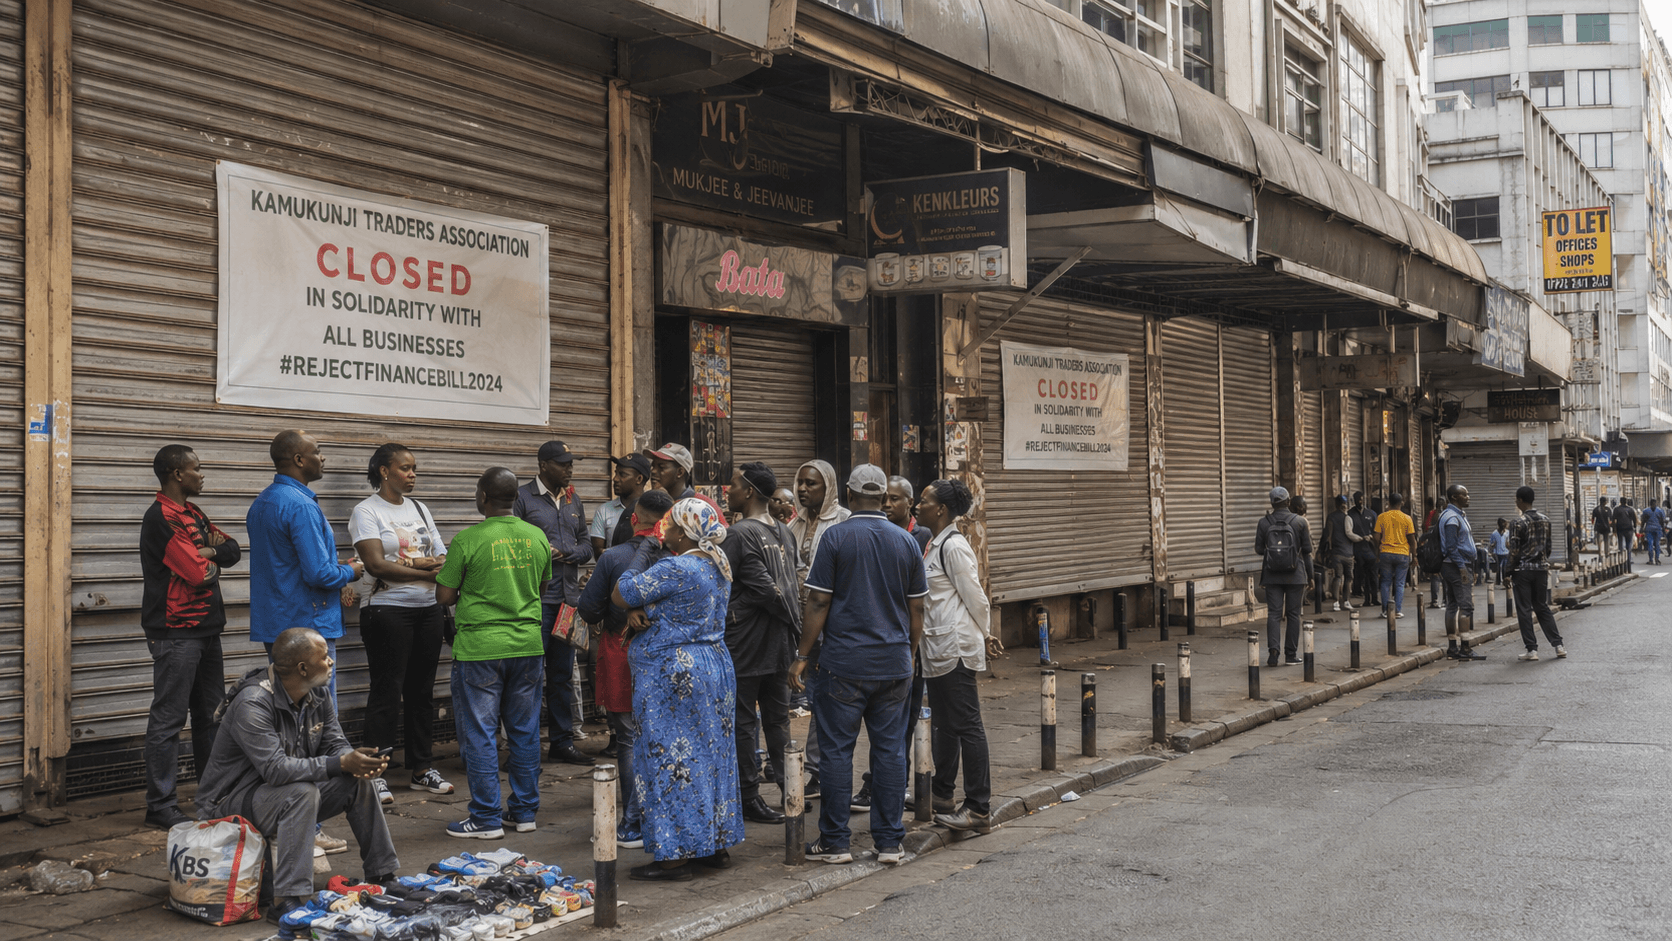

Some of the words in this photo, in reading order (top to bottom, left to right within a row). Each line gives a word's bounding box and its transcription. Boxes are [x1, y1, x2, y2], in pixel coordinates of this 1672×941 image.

[701, 101, 747, 145] MJ
[673, 167, 729, 197] MUKJEE
[733, 182, 743, 200] &
[747, 185, 814, 216] JEEVANJEE
[913, 186, 1000, 213] KENKLEURS
[251, 189, 357, 228] KAMUKUNJI
[363, 209, 434, 241] TRADERS
[439, 224, 529, 259] ASSOCIATION
[1544, 213, 1569, 237] TO
[1575, 210, 1608, 234] LET
[1556, 237, 1598, 253] OFFICES
[1560, 253, 1594, 267] SHOPS
[316, 242, 472, 296] CLOSED
[715, 249, 785, 299] Bata
[306, 286, 325, 308] IN
[332, 289, 436, 322] SOLIDARITY
[440, 305, 481, 328] WITH
[323, 324, 356, 347] ALL
[363, 328, 465, 358] BUSINESSES
[279, 354, 503, 393] #REJECTFINANCEBILL2024
[1013, 353, 1053, 369] KAMUKUNJI
[1038, 378, 1098, 401] CLOSED
[1034, 403, 1042, 414] IN
[1043, 404, 1084, 417] SOLIDARITY
[1086, 406, 1103, 418] WITH
[1041, 423, 1054, 434] ALL
[170, 843, 210, 884] KBS
